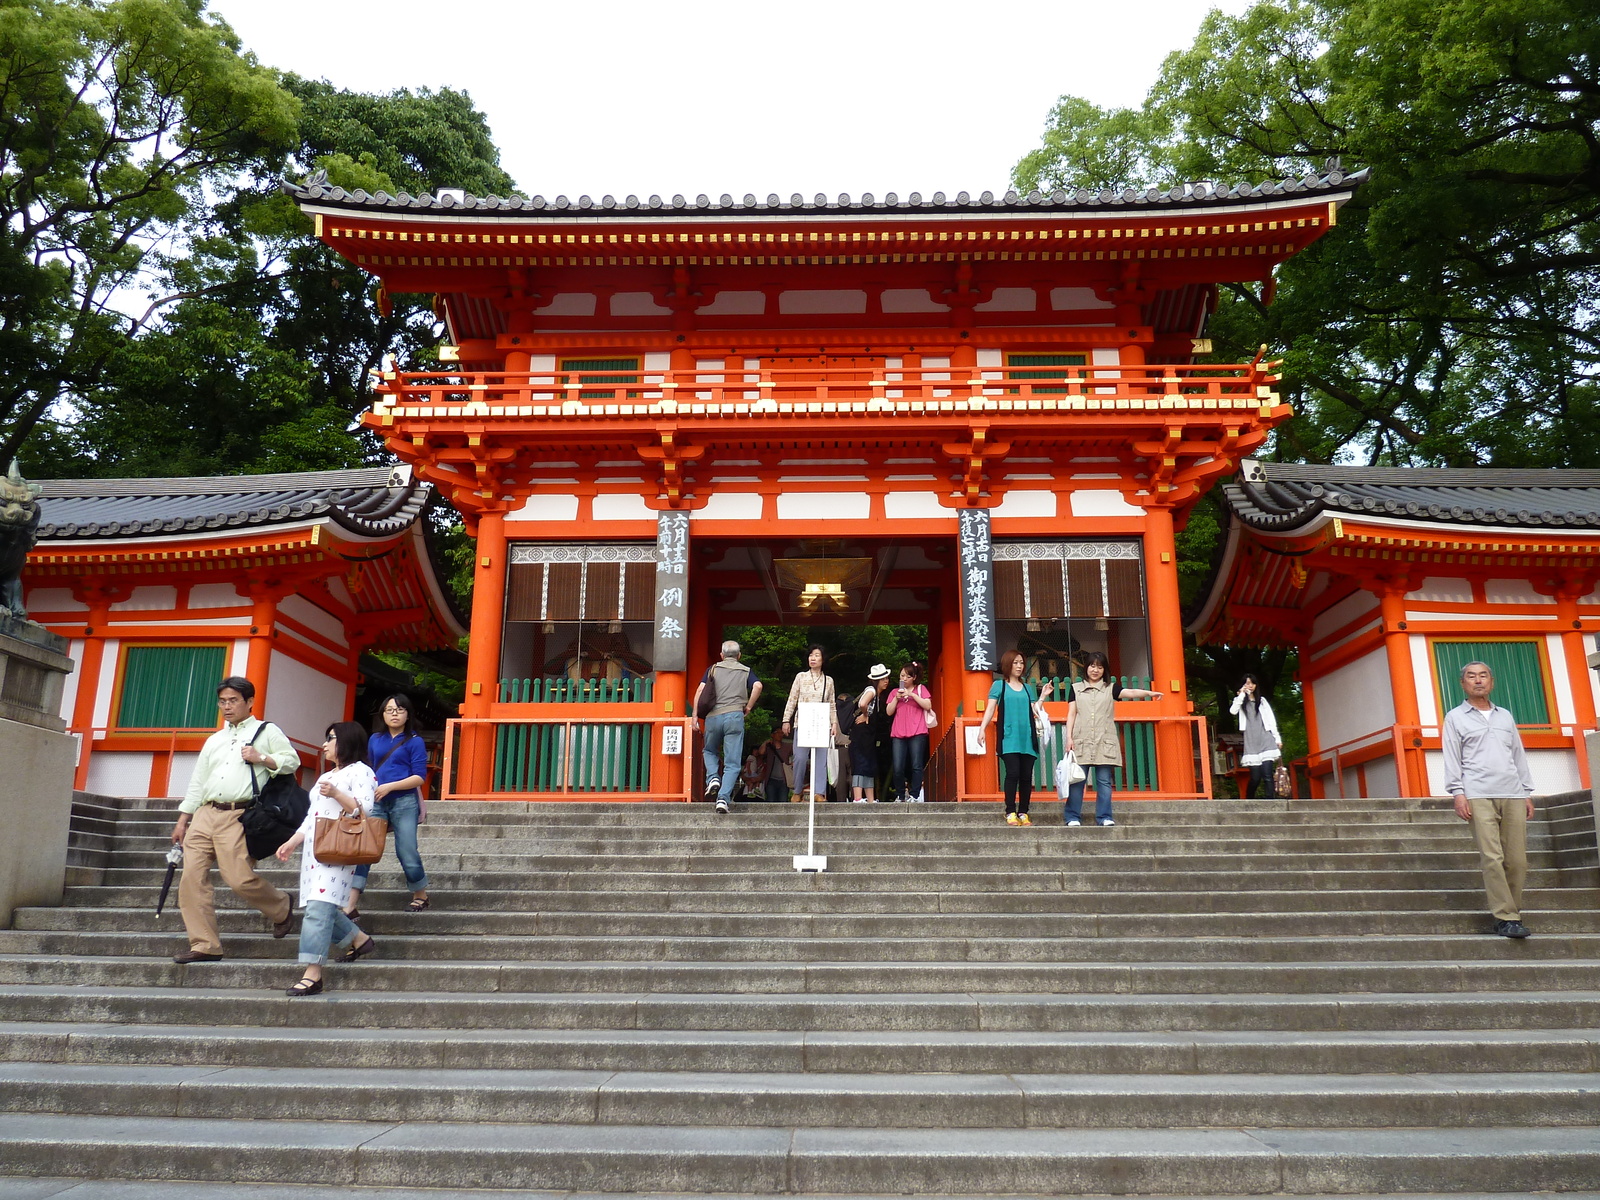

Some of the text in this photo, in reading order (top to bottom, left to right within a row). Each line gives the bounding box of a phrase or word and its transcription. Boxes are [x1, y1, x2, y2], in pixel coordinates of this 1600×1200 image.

[656, 515, 673, 575] 午前十時
[672, 513, 688, 574] 六月十五日
[960, 510, 977, 568] 午後七時半
[973, 510, 990, 563] 六月十四日
[658, 587, 683, 639] 例祭
